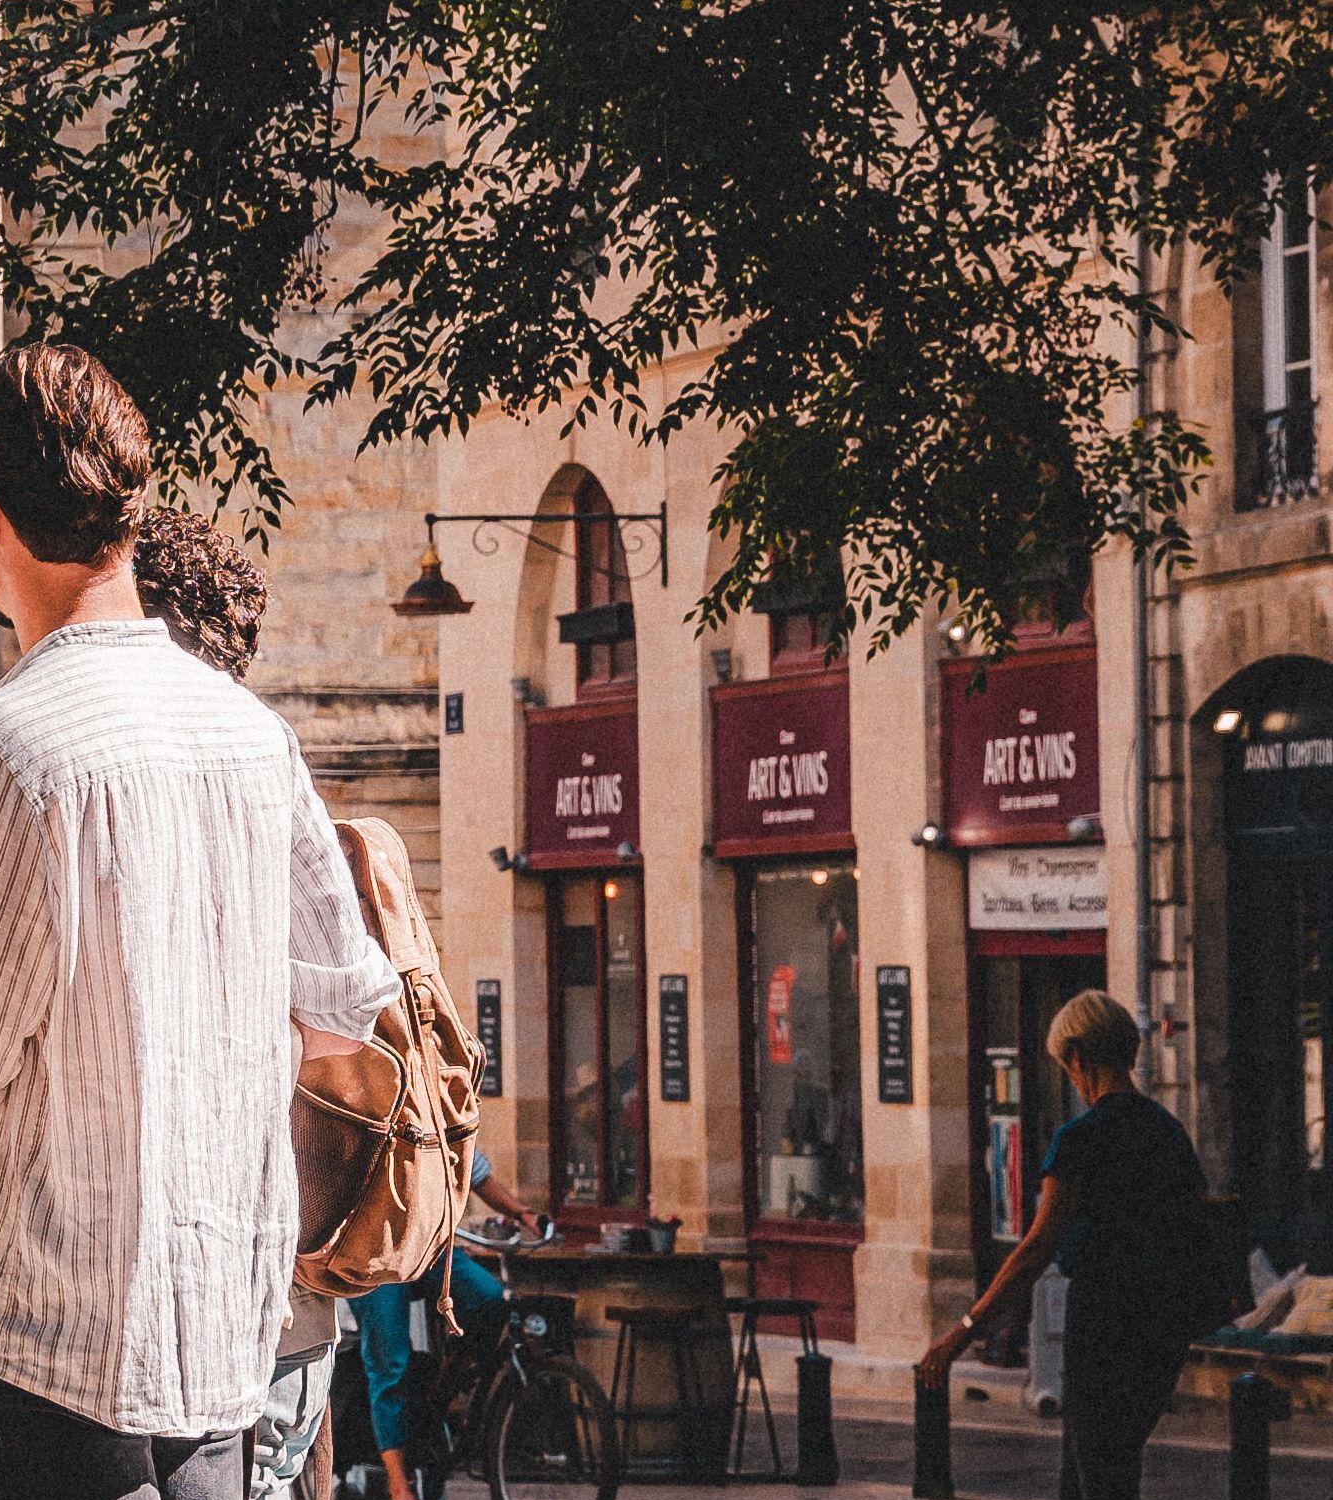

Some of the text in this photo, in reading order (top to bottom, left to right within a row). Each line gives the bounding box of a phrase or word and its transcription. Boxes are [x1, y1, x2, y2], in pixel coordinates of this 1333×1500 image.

[748, 750, 829, 801] ART & VINS
[983, 731, 1076, 786] ART & VINS
[556, 772, 622, 817] ART & VINS
